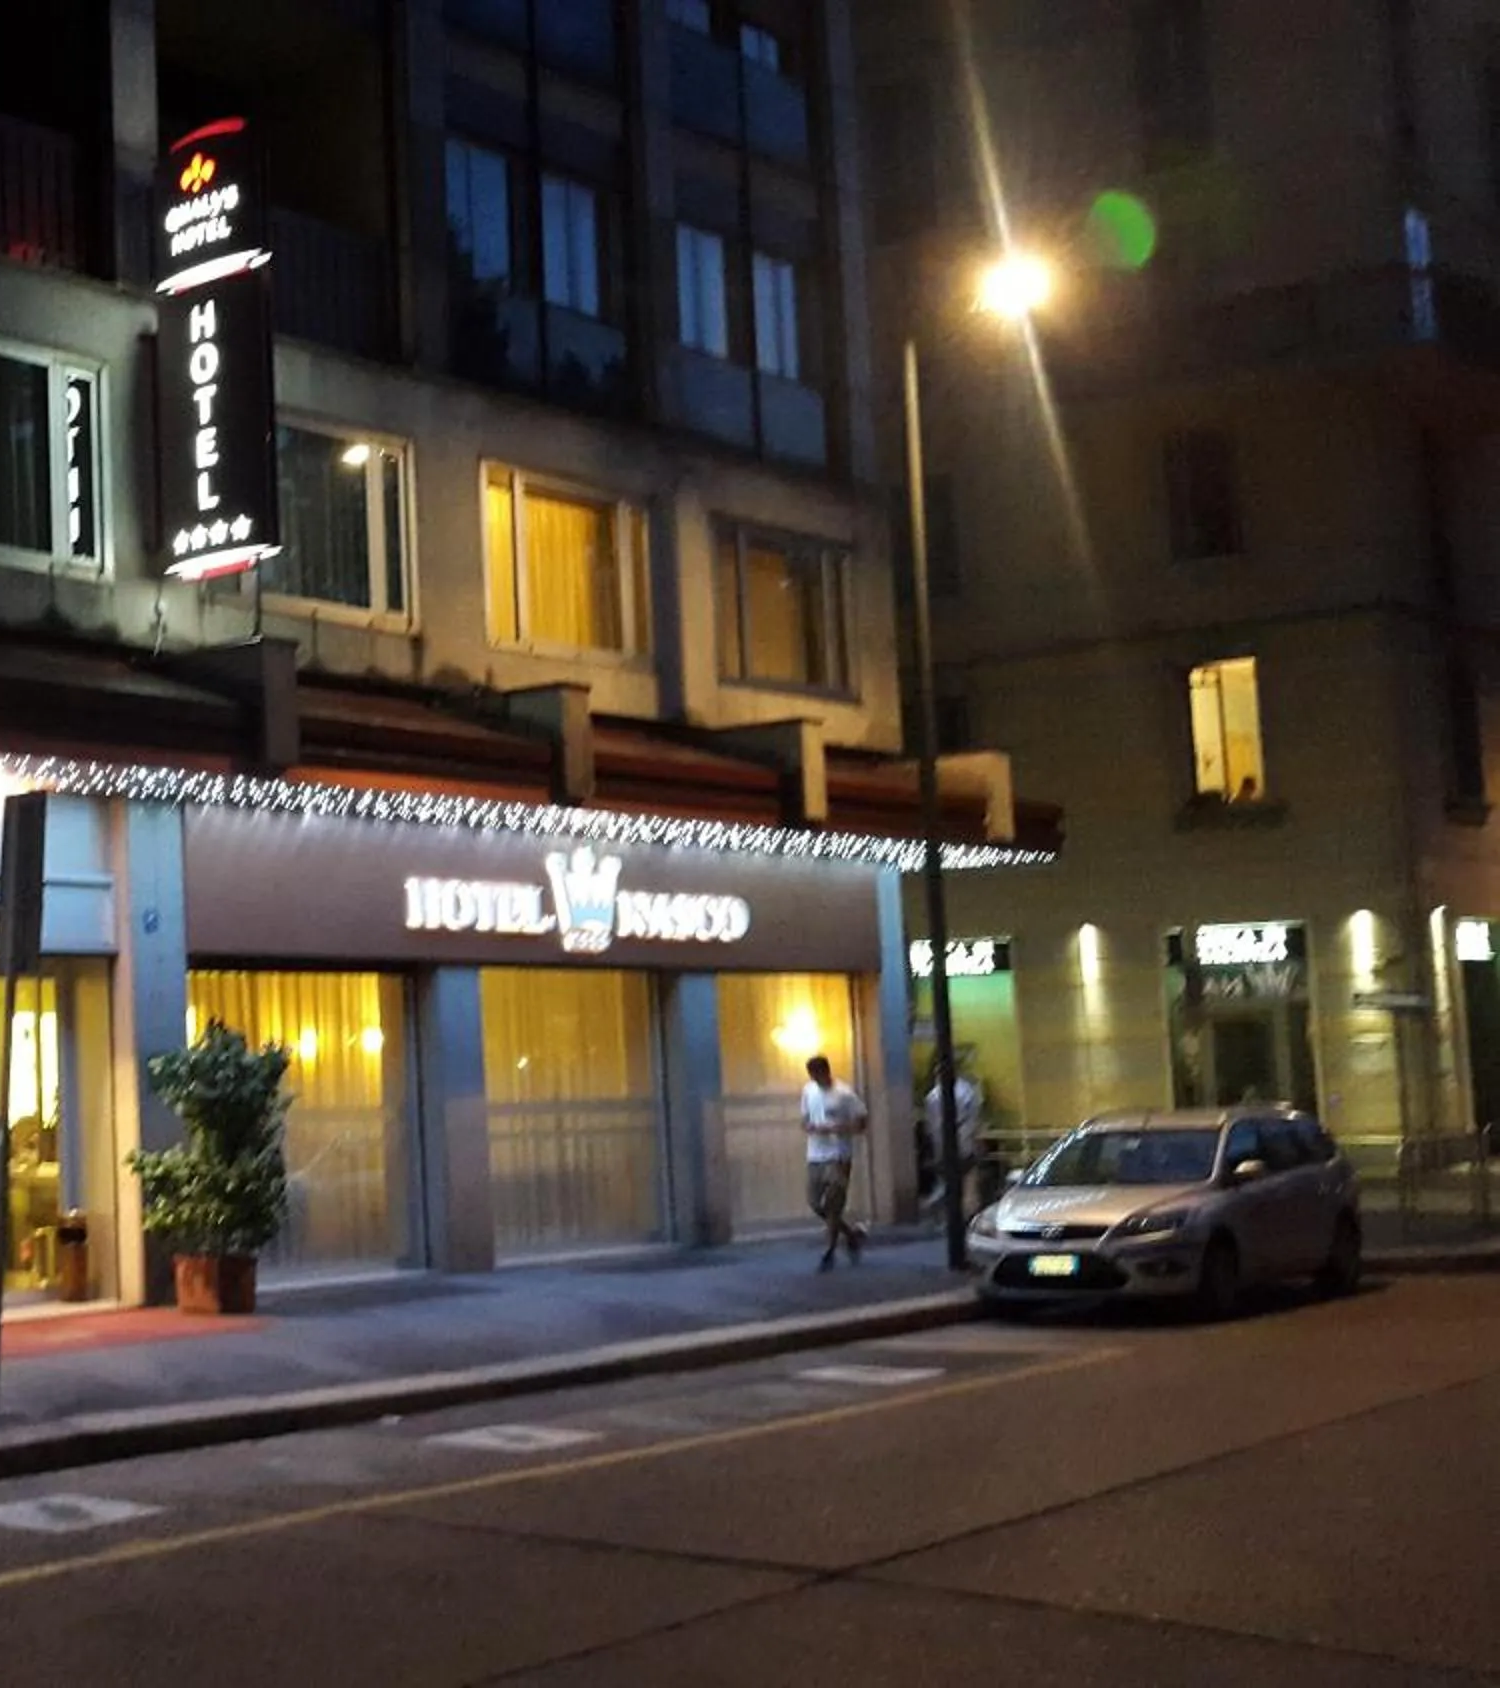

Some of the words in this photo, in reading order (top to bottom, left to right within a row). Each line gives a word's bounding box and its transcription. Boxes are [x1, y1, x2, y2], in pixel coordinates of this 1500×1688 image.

[170, 215, 232, 257] HOTEL
[189, 299, 220, 511] HOTEL
[403, 875, 556, 934] HOTEL
[615, 889, 749, 942] NASCO
